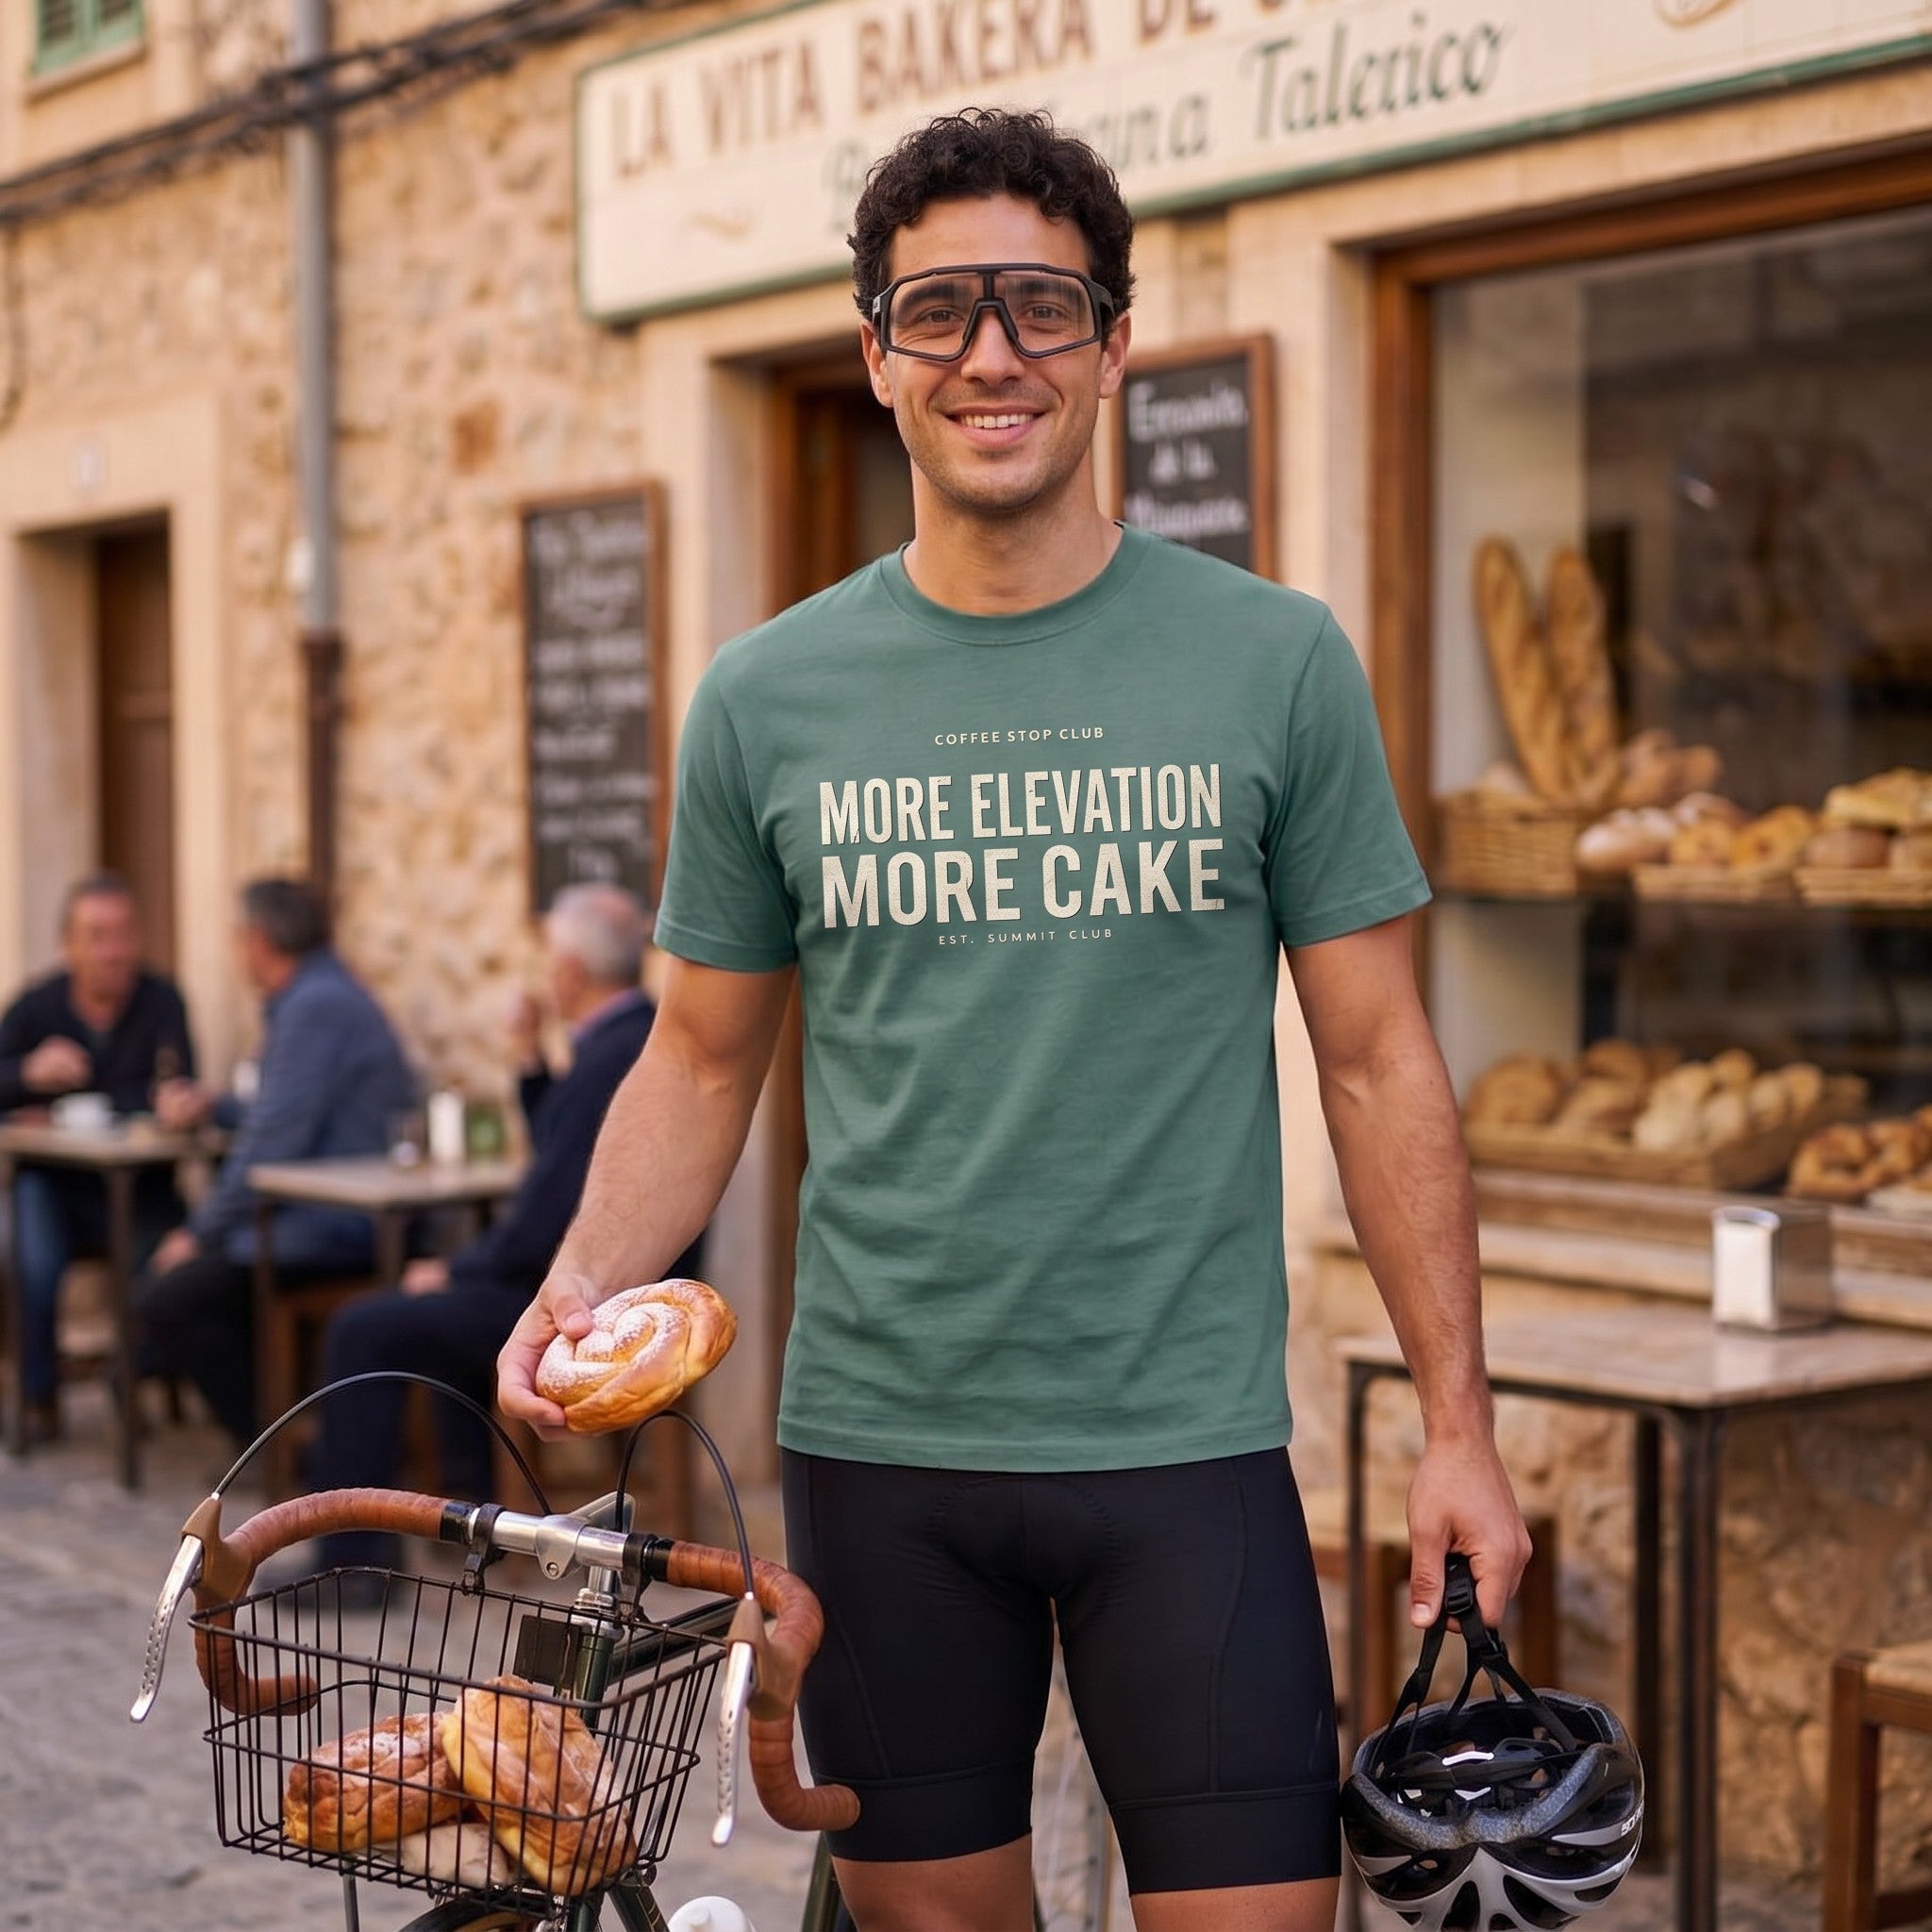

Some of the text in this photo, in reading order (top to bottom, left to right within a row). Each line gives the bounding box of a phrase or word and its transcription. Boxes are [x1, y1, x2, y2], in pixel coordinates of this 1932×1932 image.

[613, 81, 674, 179] LA
[700, 40, 822, 158] VITA
[934, 726, 1105, 746] COFFEE STOP CLUB
[819, 762, 1223, 846] MORE ELEVATION
[821, 838, 1226, 929] MORE CAKE
[939, 928, 1112, 946] EST. SUMMIT CLUB
